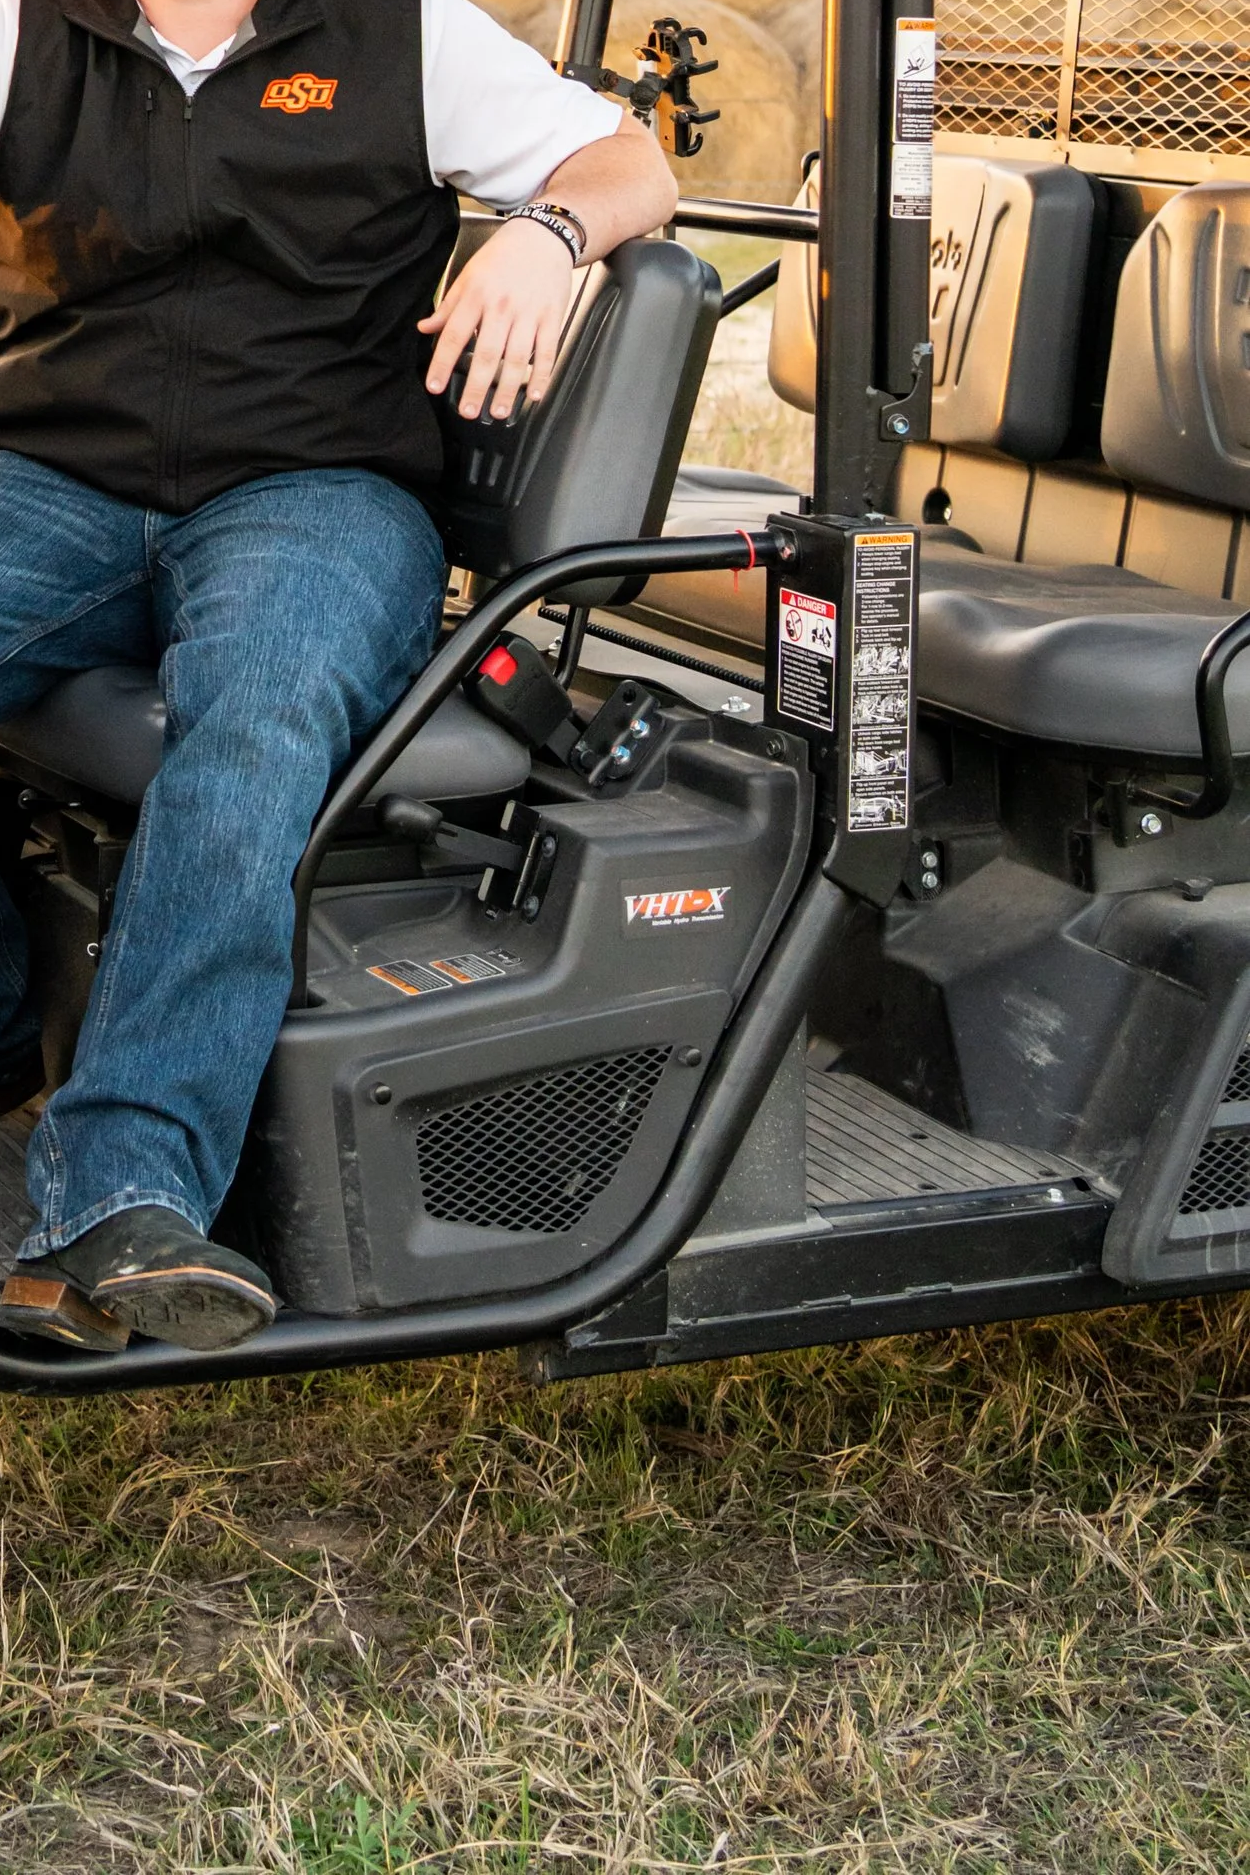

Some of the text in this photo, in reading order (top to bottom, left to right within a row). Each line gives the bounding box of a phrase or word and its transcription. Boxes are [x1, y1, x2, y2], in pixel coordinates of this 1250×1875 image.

[266, 77, 332, 110] OSU
[869, 536, 908, 544] WARNING
[797, 596, 827, 616] DANGER
[624, 886, 732, 926] VHT-X
